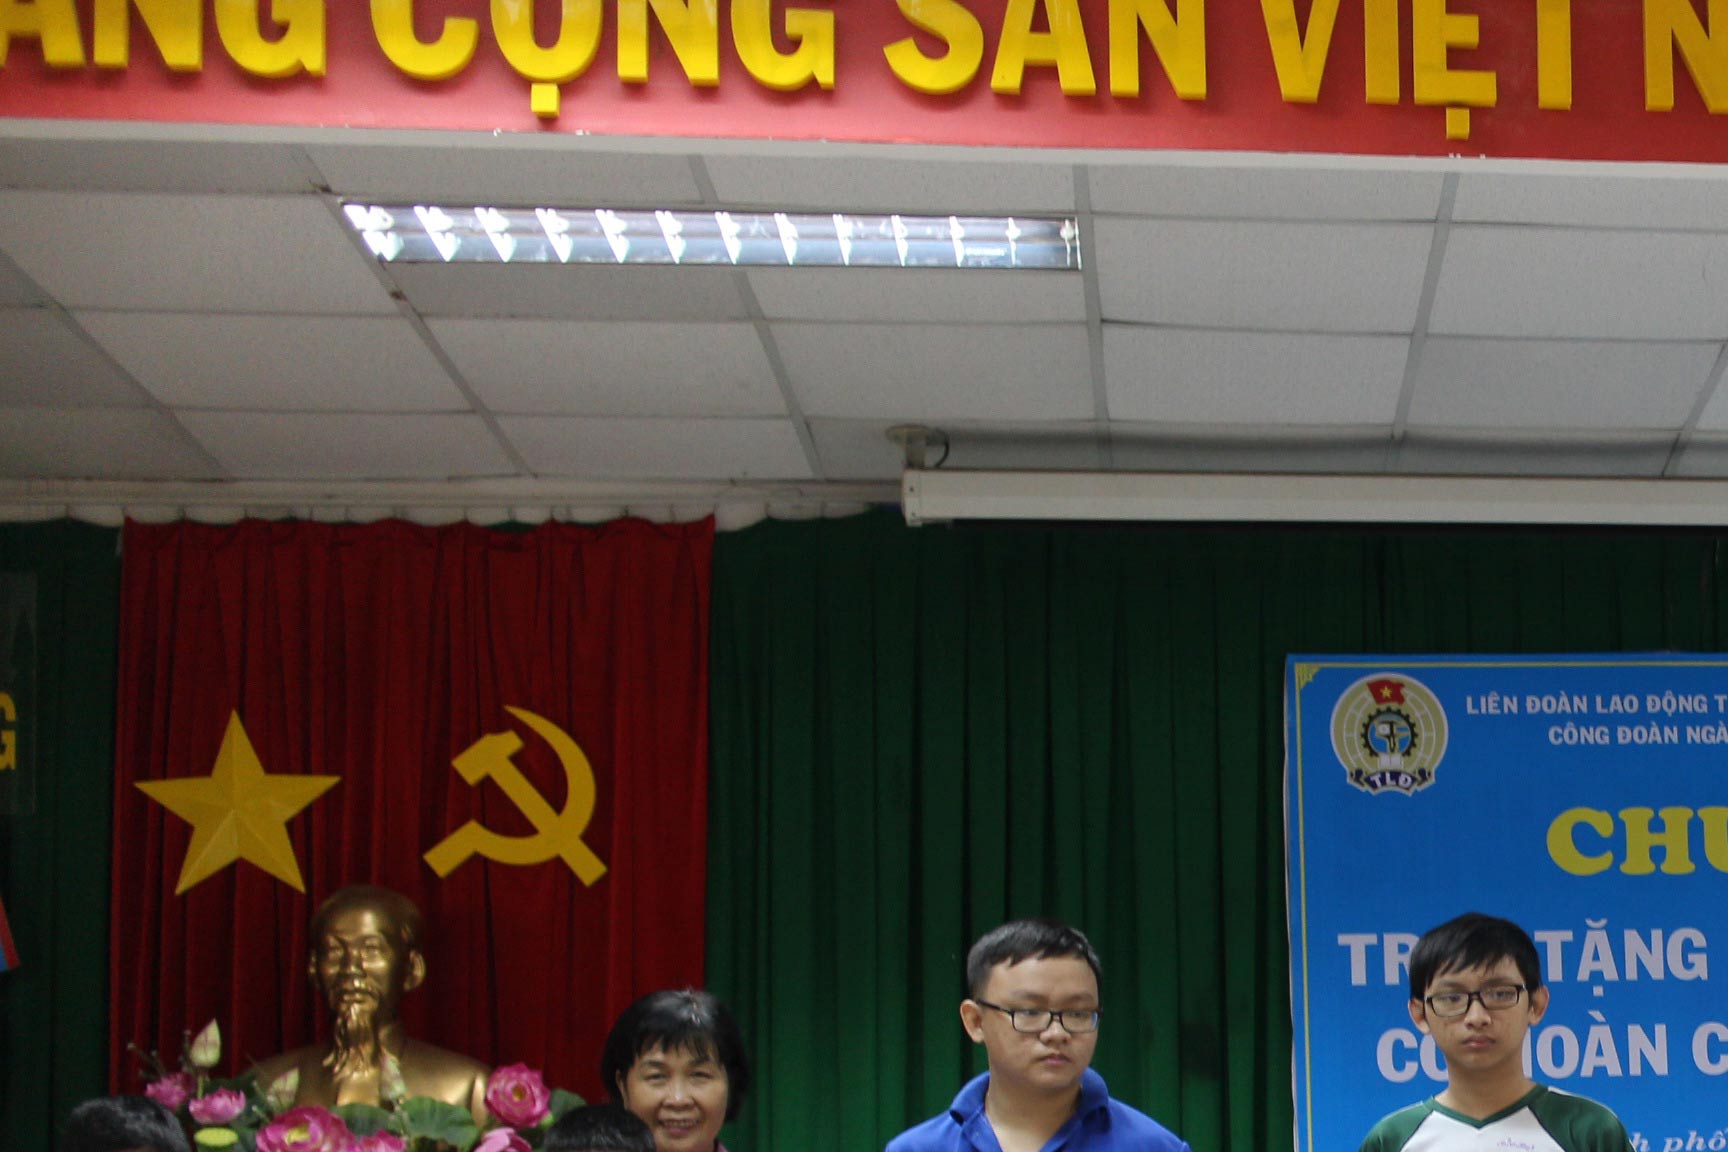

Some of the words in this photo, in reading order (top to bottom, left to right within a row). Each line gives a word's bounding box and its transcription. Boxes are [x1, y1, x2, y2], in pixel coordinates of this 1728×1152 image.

[1466, 693, 1518, 714] LIÊN
[1526, 693, 1588, 713] ĐOÀN
[1596, 695, 1639, 713] LAO
[1647, 692, 1708, 714] ĐỘNG
[1549, 725, 1610, 744] CÔNG
[1617, 725, 1679, 744] ĐOÀN
[1535, 918, 1708, 997] TẶNG
